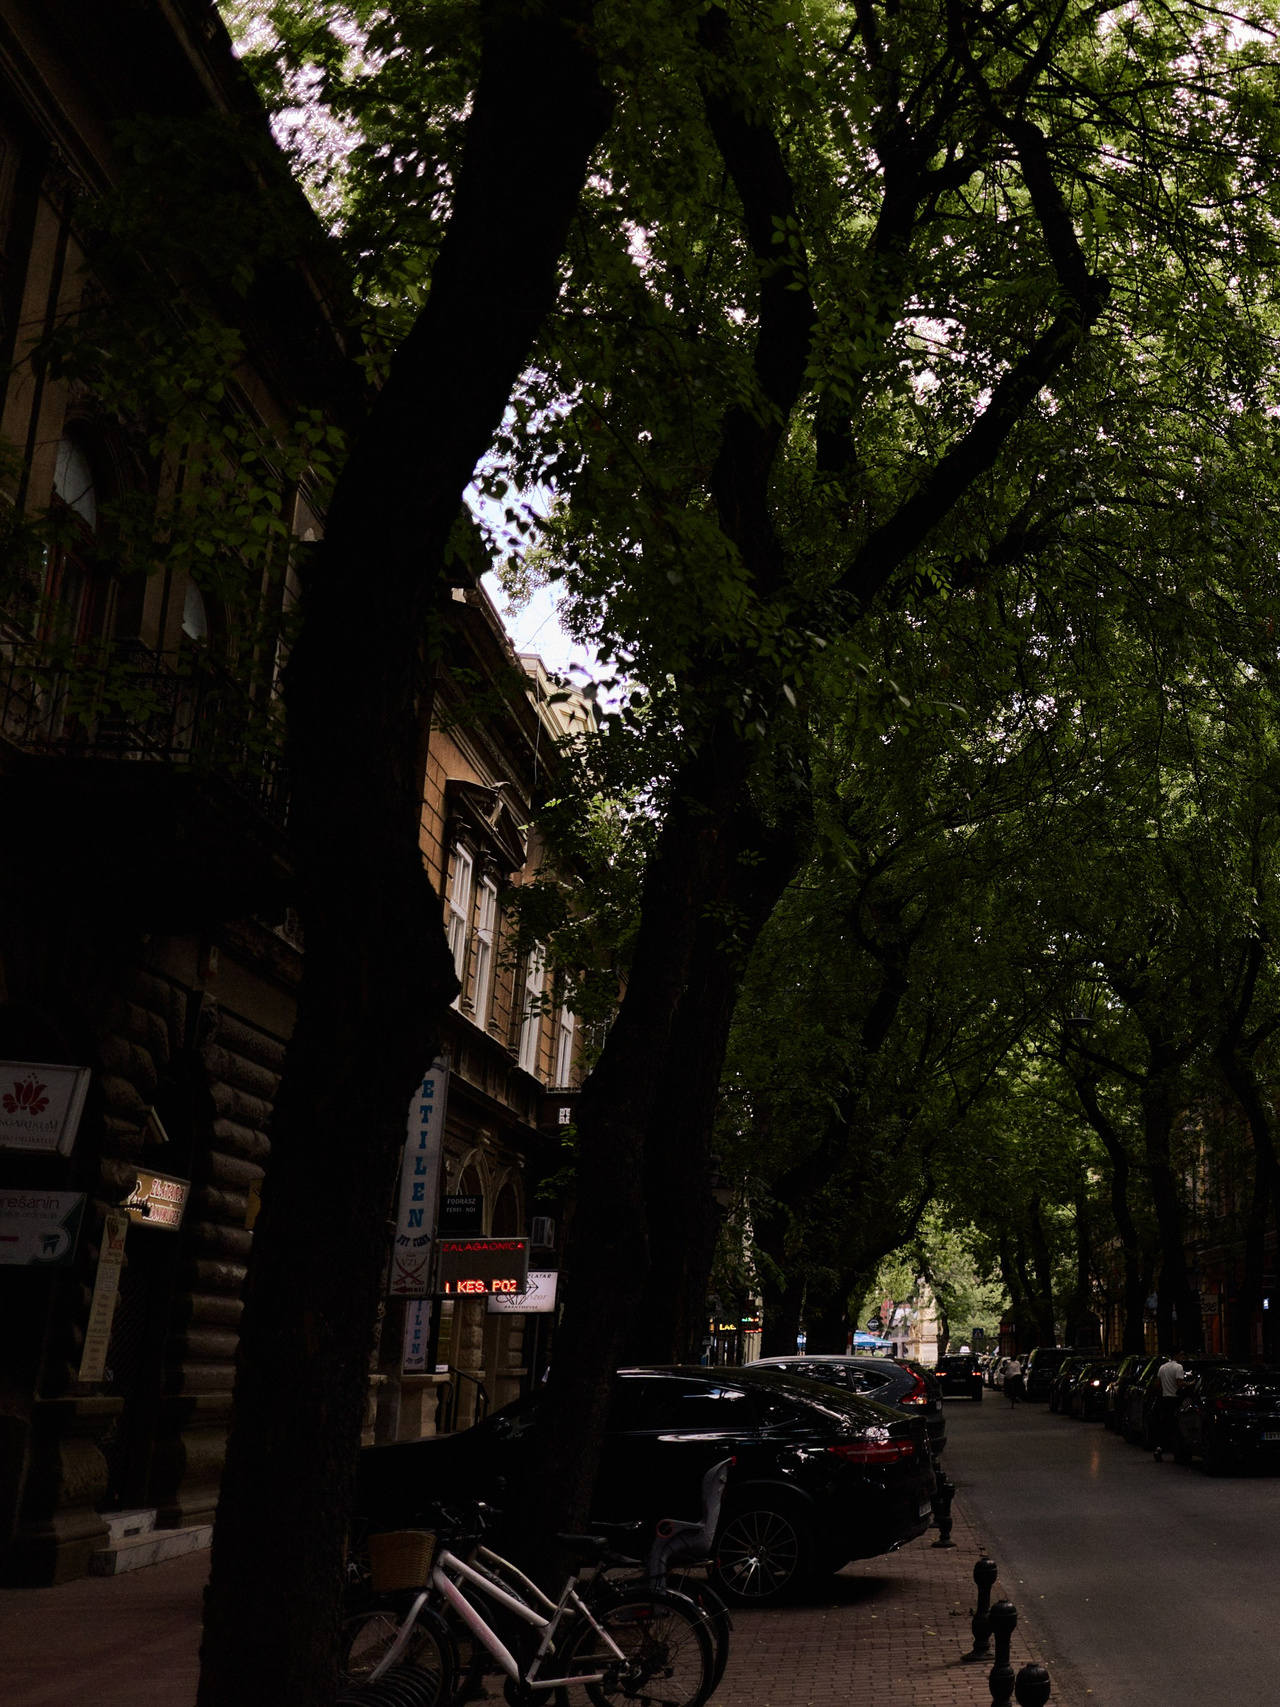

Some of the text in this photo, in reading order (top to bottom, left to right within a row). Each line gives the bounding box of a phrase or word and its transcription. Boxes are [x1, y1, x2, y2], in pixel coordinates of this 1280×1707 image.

[407, 1080, 434, 1227] ETILEN
[442, 1242, 525, 1252] ZALAGAONICA
[411, 1300, 422, 1354] ILEN
